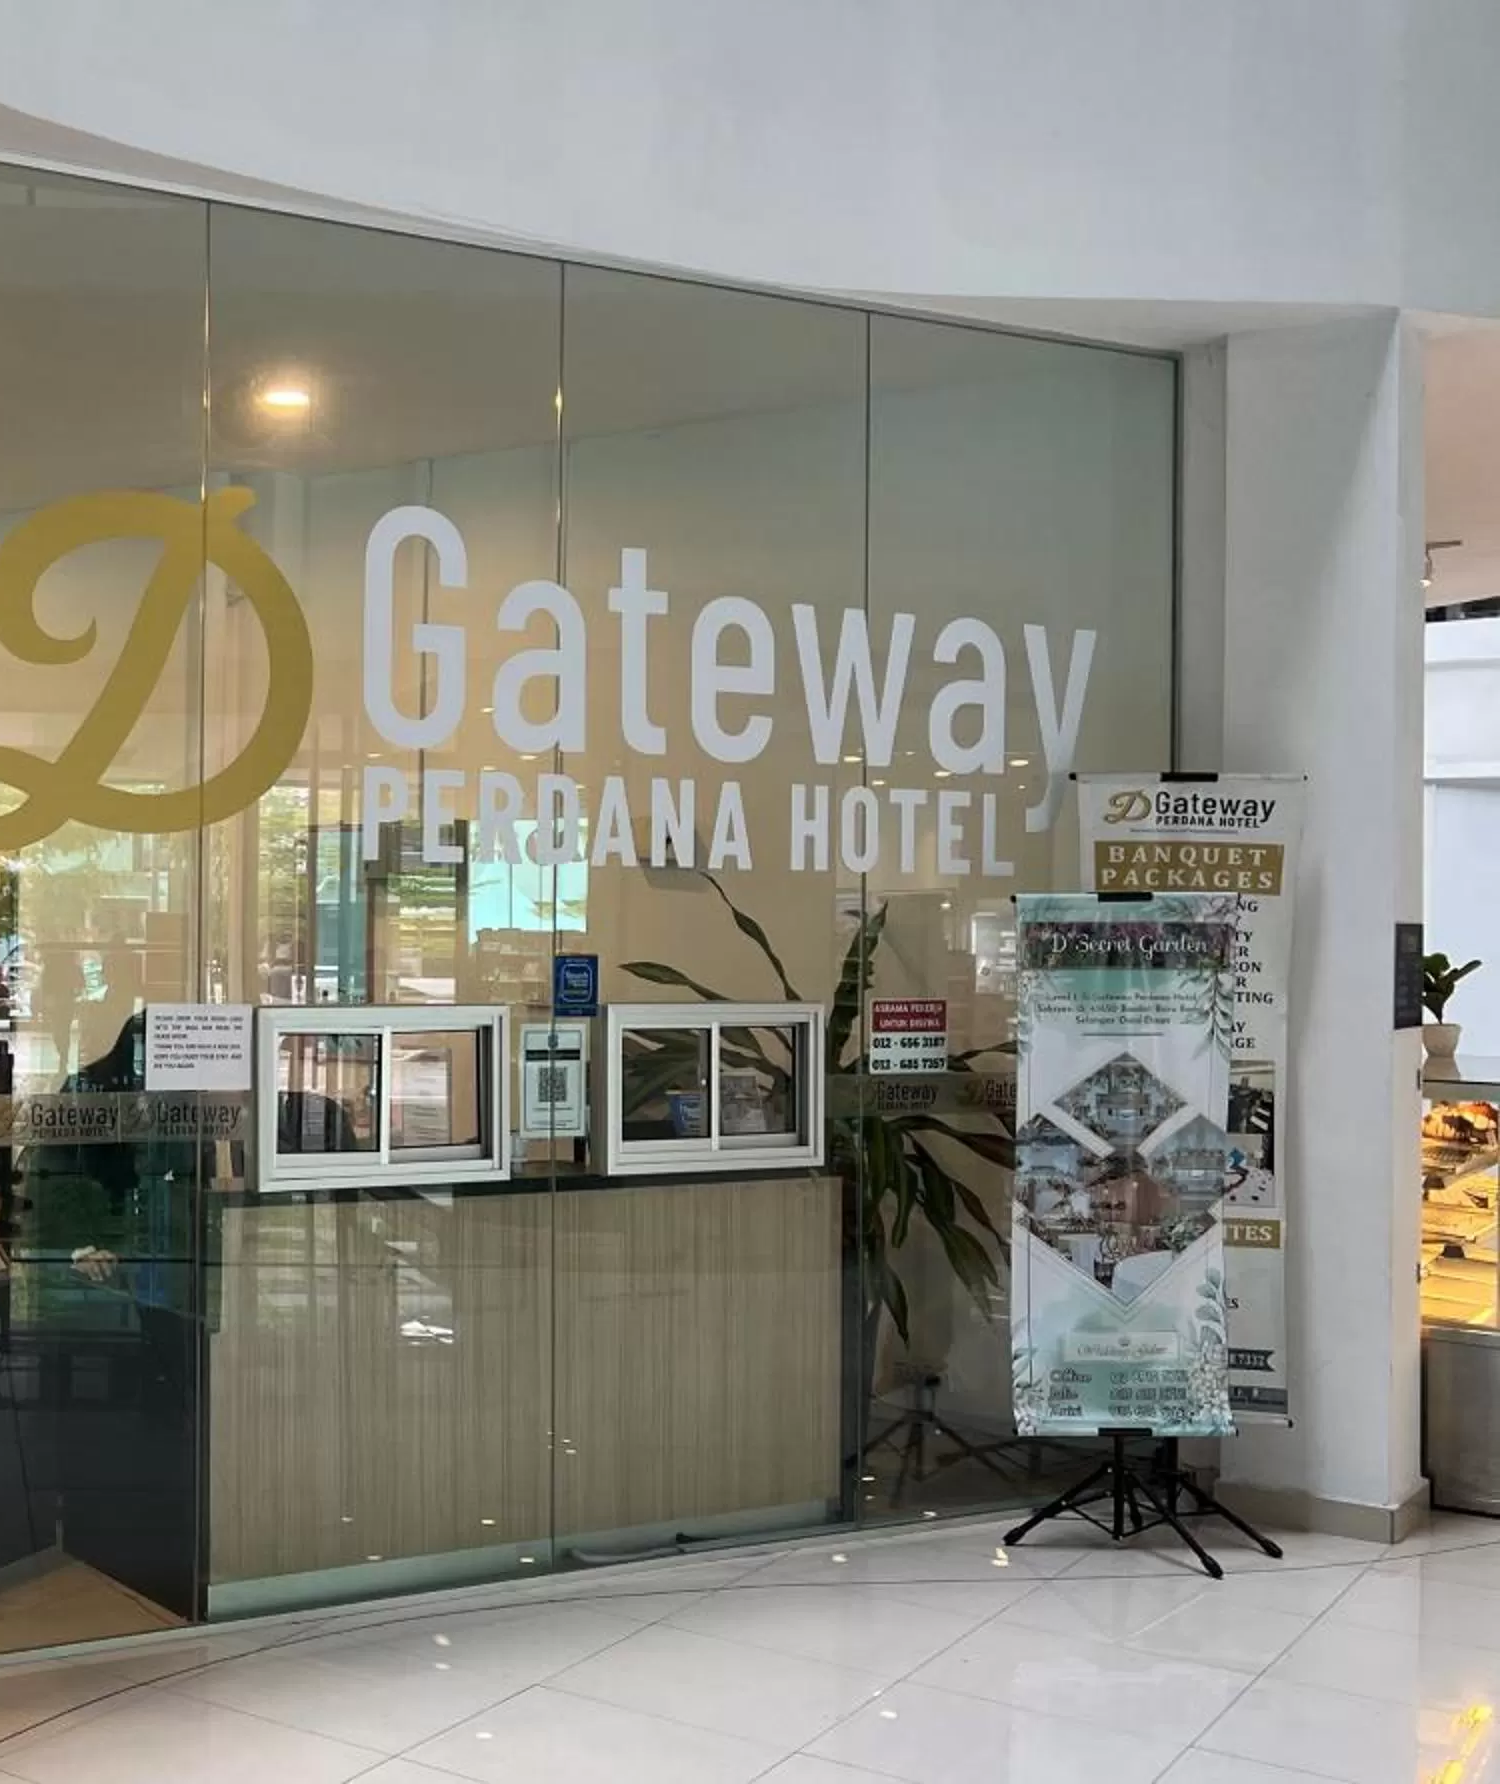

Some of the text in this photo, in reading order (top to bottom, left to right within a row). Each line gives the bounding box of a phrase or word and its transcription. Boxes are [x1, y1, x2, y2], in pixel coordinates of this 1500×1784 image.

[364, 505, 1097, 833] Gateway
[1103, 789, 1276, 824] D Gateway
[362, 765, 1015, 876] PERDANA HOTEL
[1155, 816, 1261, 829] PERDANA HOTEL
[1108, 846, 1268, 867] BANQUET
[1101, 868, 1274, 889] PACKAGES
[1236, 901, 1259, 913] NG
[1075, 933, 1134, 953] Secret
[1139, 932, 1207, 960] Garden
[1236, 991, 1274, 1004] TING
[873, 1037, 891, 1049] 012
[921, 1058, 945, 1070] 7357
[986, 1079, 1018, 1101] Gate
[30, 1103, 120, 1128] Gateway
[156, 1101, 242, 1129] Gateway
